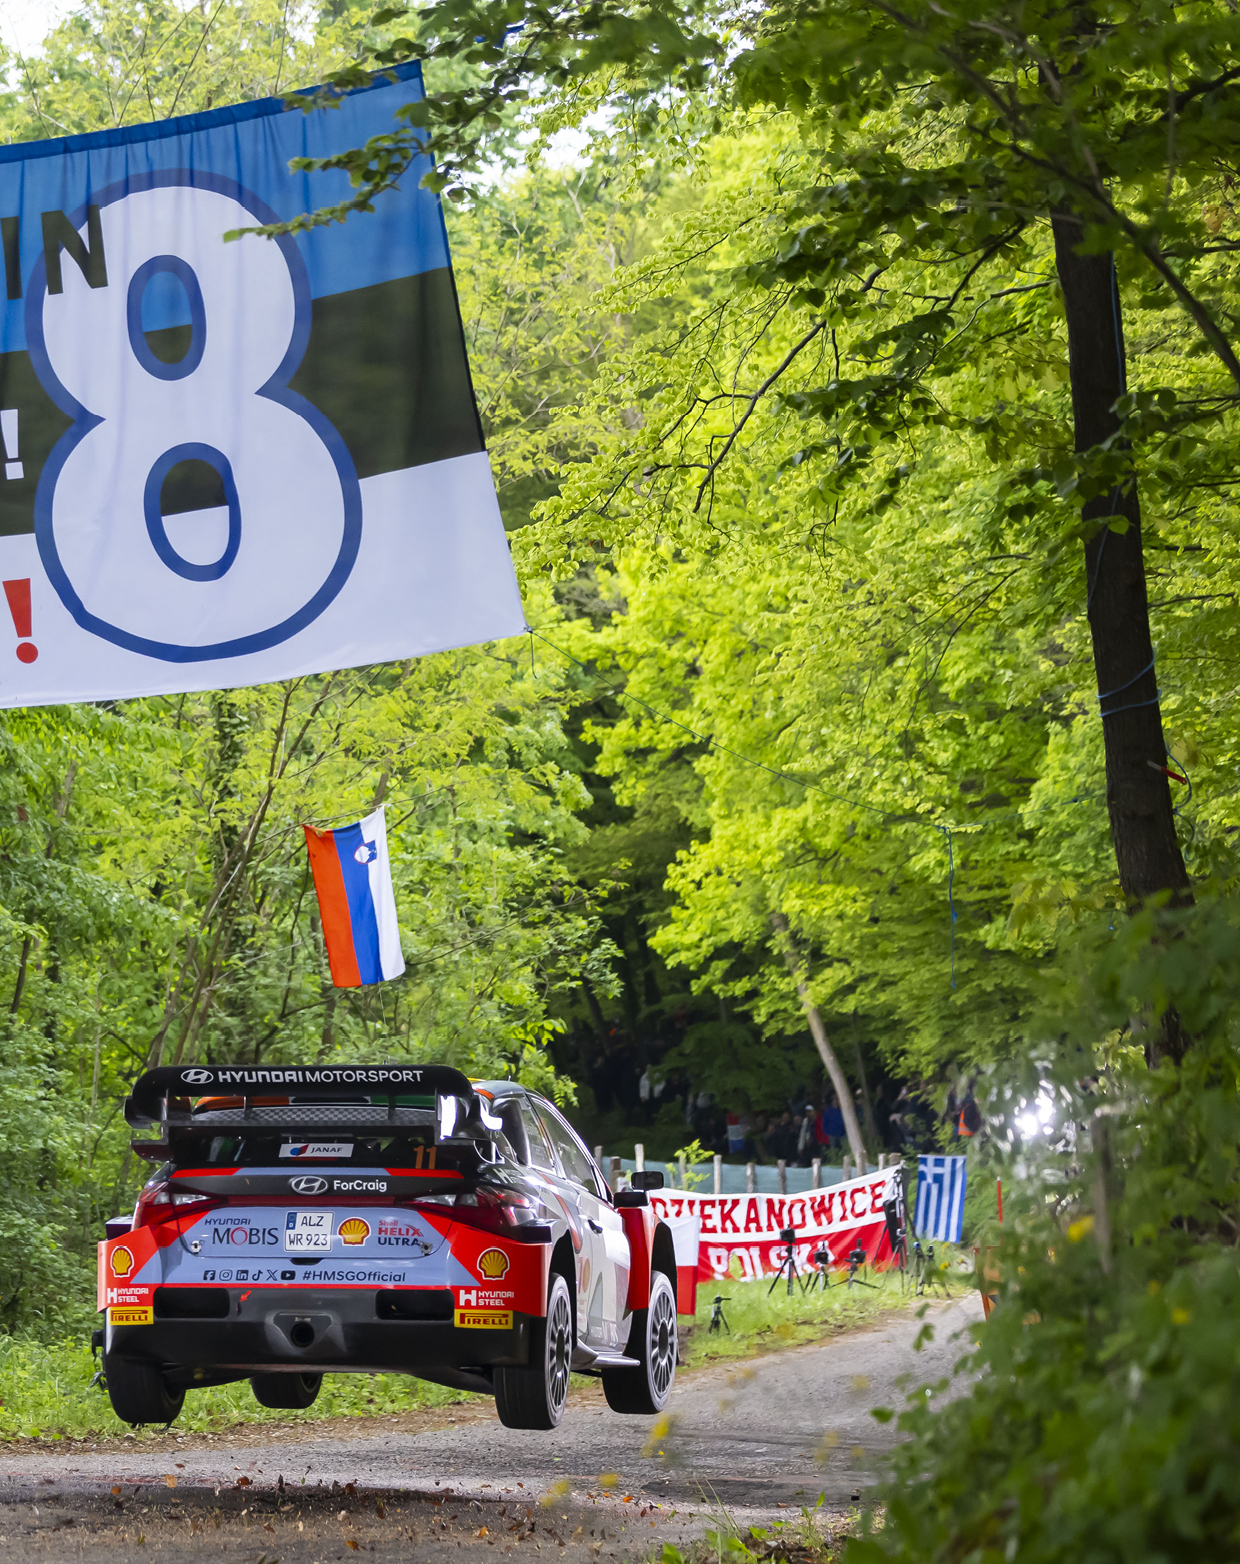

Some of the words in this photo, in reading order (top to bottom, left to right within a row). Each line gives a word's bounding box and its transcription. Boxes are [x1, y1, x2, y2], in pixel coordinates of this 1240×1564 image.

[23, 167, 363, 663] 8
[413, 1145, 437, 1170] 11
[333, 1179, 388, 1193] ForCraig
[204, 1218, 251, 1226] HYUNDAI
[300, 1215, 325, 1227] ALZ
[378, 1219, 399, 1227] Shell
[211, 1226, 280, 1246] MOBIS
[377, 1224, 424, 1238] HELIX
[288, 1233, 303, 1246] WR
[306, 1233, 328, 1246] 923
[377, 1237, 421, 1247] ULTRA
[302, 1270, 407, 1283] #HMSGOfficial
[117, 1287, 149, 1295] HYUNDAI
[478, 1290, 515, 1299] HYUNDAI
[117, 1295, 140, 1303] STEEL
[478, 1298, 506, 1307] STEEL
[110, 1309, 149, 1322] PIRELLI
[459, 1312, 510, 1326] PIRELLI
